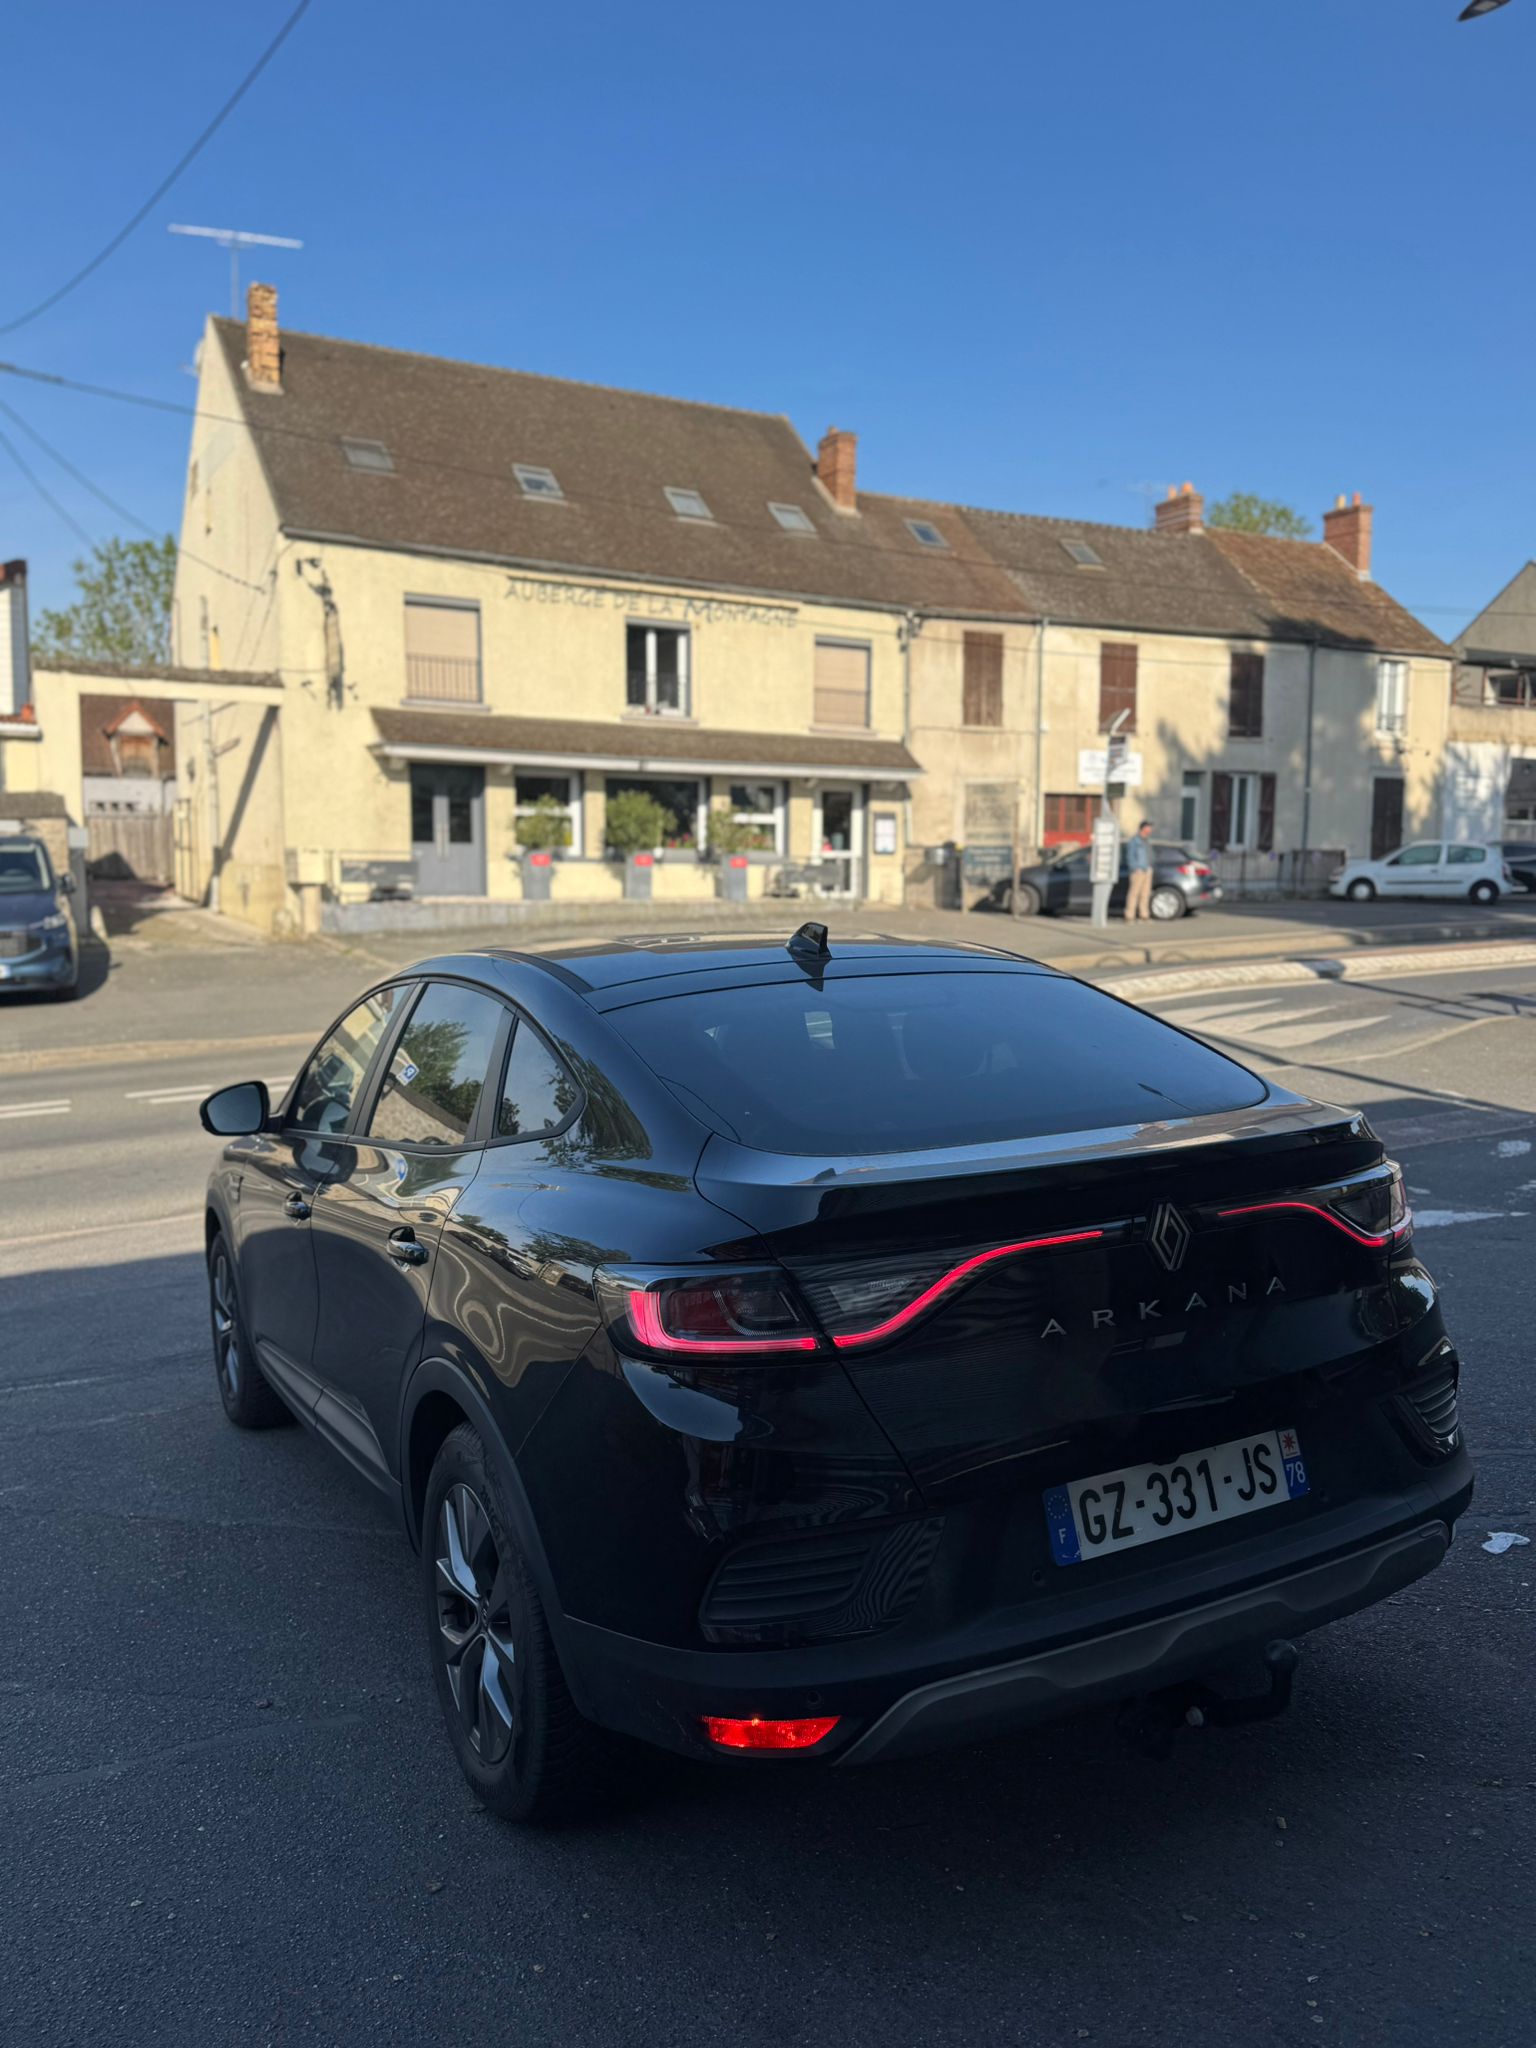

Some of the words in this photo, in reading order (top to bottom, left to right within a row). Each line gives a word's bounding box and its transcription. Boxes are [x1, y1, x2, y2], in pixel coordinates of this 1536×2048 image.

[504, 579, 606, 608] AUBERGE
[613, 591, 642, 613] DE
[650, 595, 674, 615] LA
[1041, 1276, 1287, 1338] ARKANA
[1285, 1460, 1306, 1487] 78
[1078, 1443, 1278, 1545] GZ-331-JS
[1058, 1527, 1067, 1544] F
